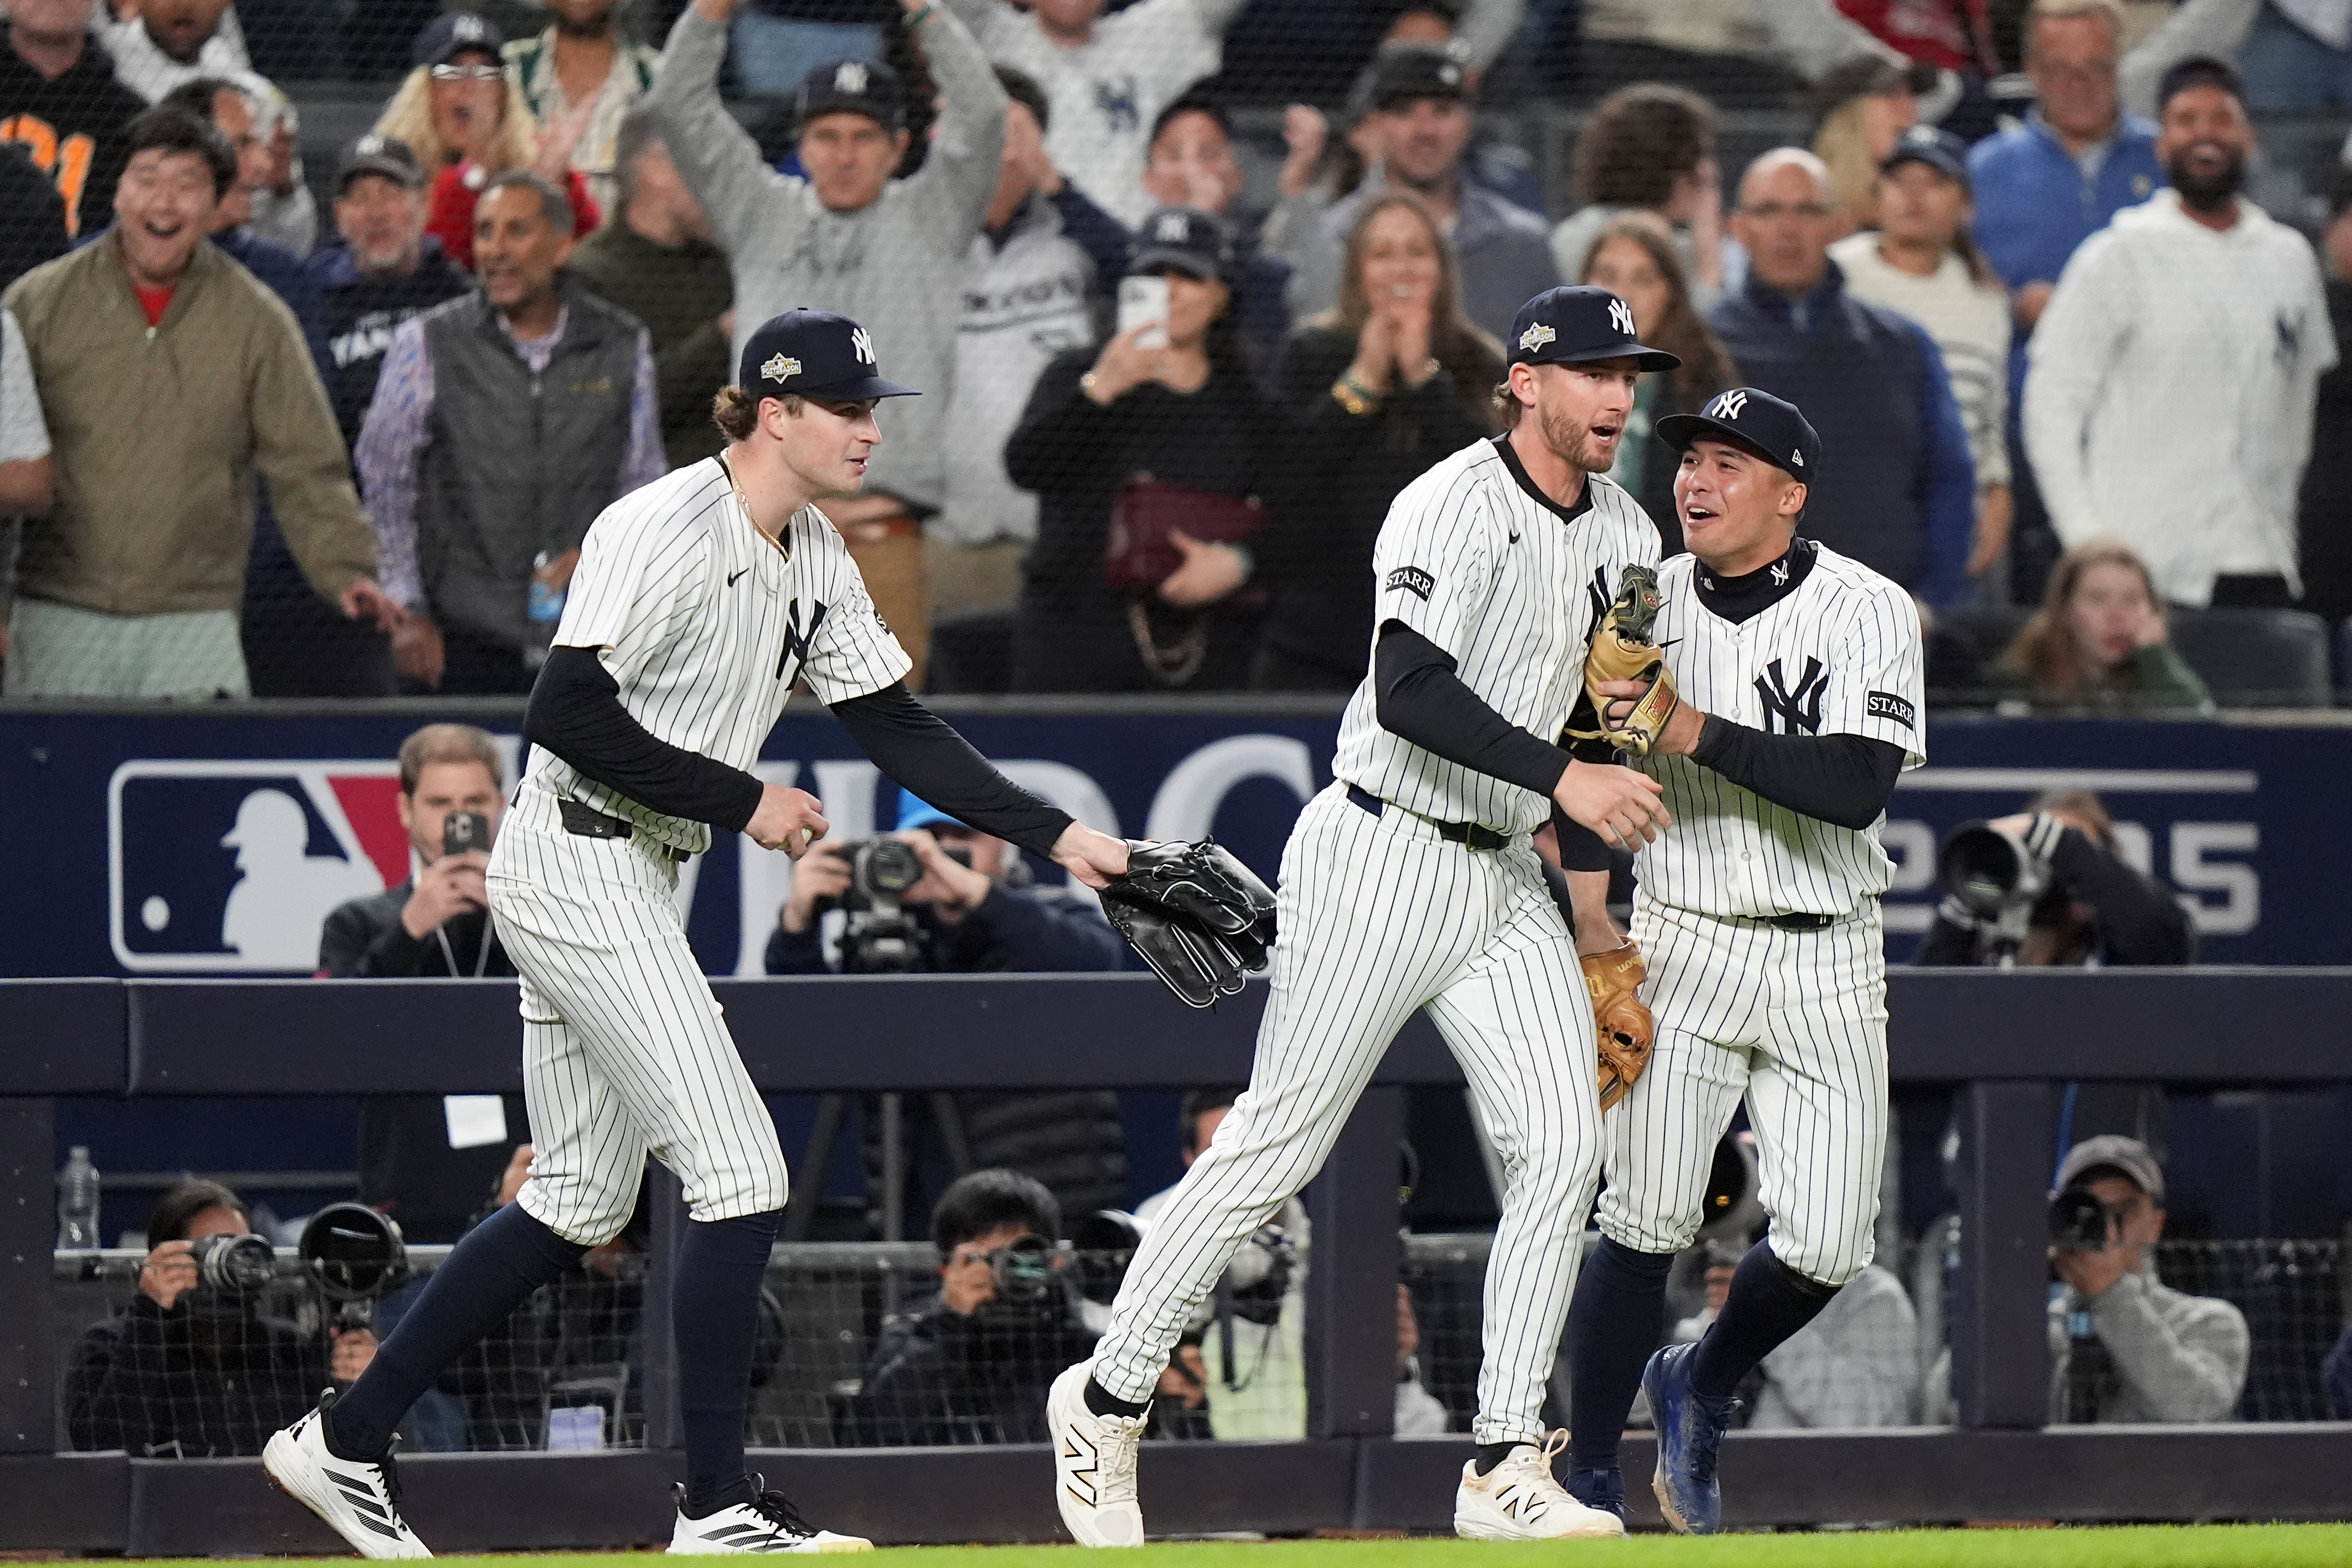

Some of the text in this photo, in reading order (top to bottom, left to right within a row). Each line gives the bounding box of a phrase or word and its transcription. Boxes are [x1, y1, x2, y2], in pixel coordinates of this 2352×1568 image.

[1607, 298, 1635, 335] NY
[851, 327, 876, 365] NY
[1712, 390, 1748, 420] NY
[1387, 570, 1431, 596] STARR
[1770, 560, 1789, 586] NY
[1753, 655, 1828, 737] NY
[1868, 696, 1913, 725] STARR
